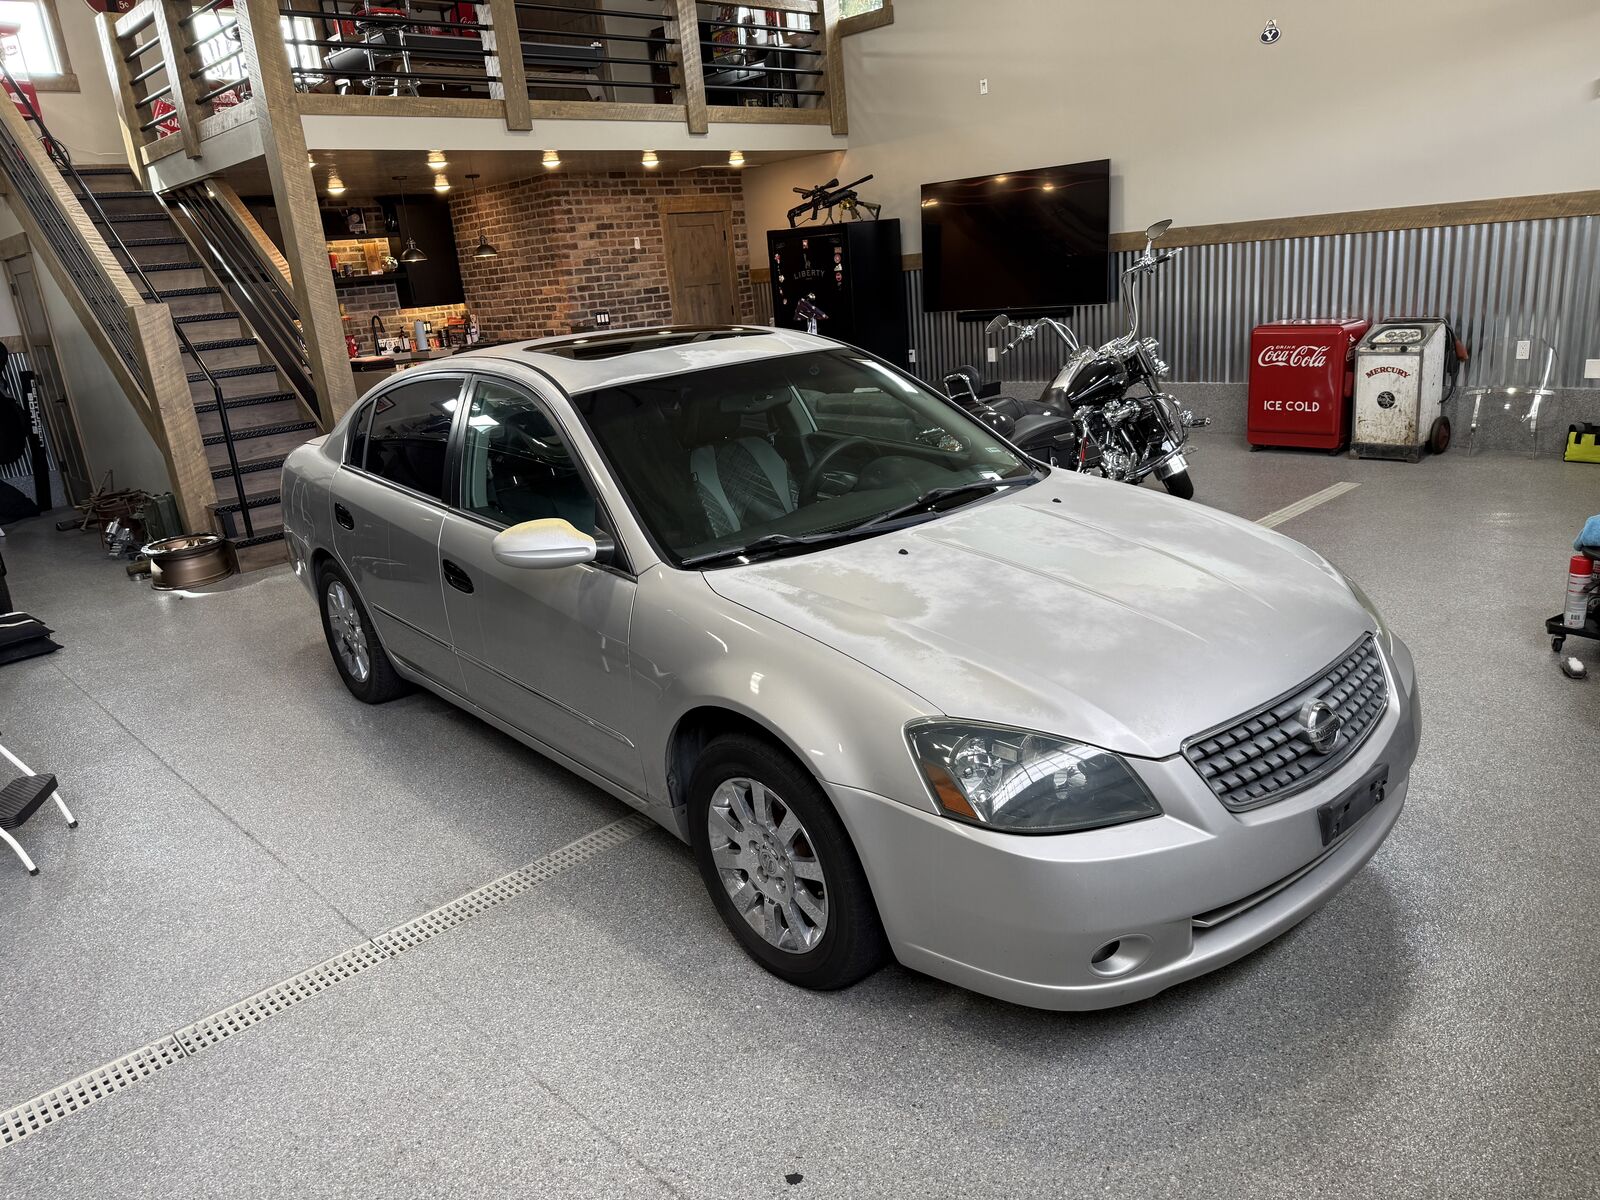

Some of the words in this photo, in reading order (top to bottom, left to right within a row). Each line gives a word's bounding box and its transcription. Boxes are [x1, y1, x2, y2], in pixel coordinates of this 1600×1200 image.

[1263, 30, 1277, 42] Y
[793, 269, 825, 280] LIBERTY
[1257, 345, 1331, 367] Coca-Cola
[1365, 366, 1411, 379] MERCURY
[1264, 400, 1282, 411] ICE
[1285, 401, 1320, 412] COLD
